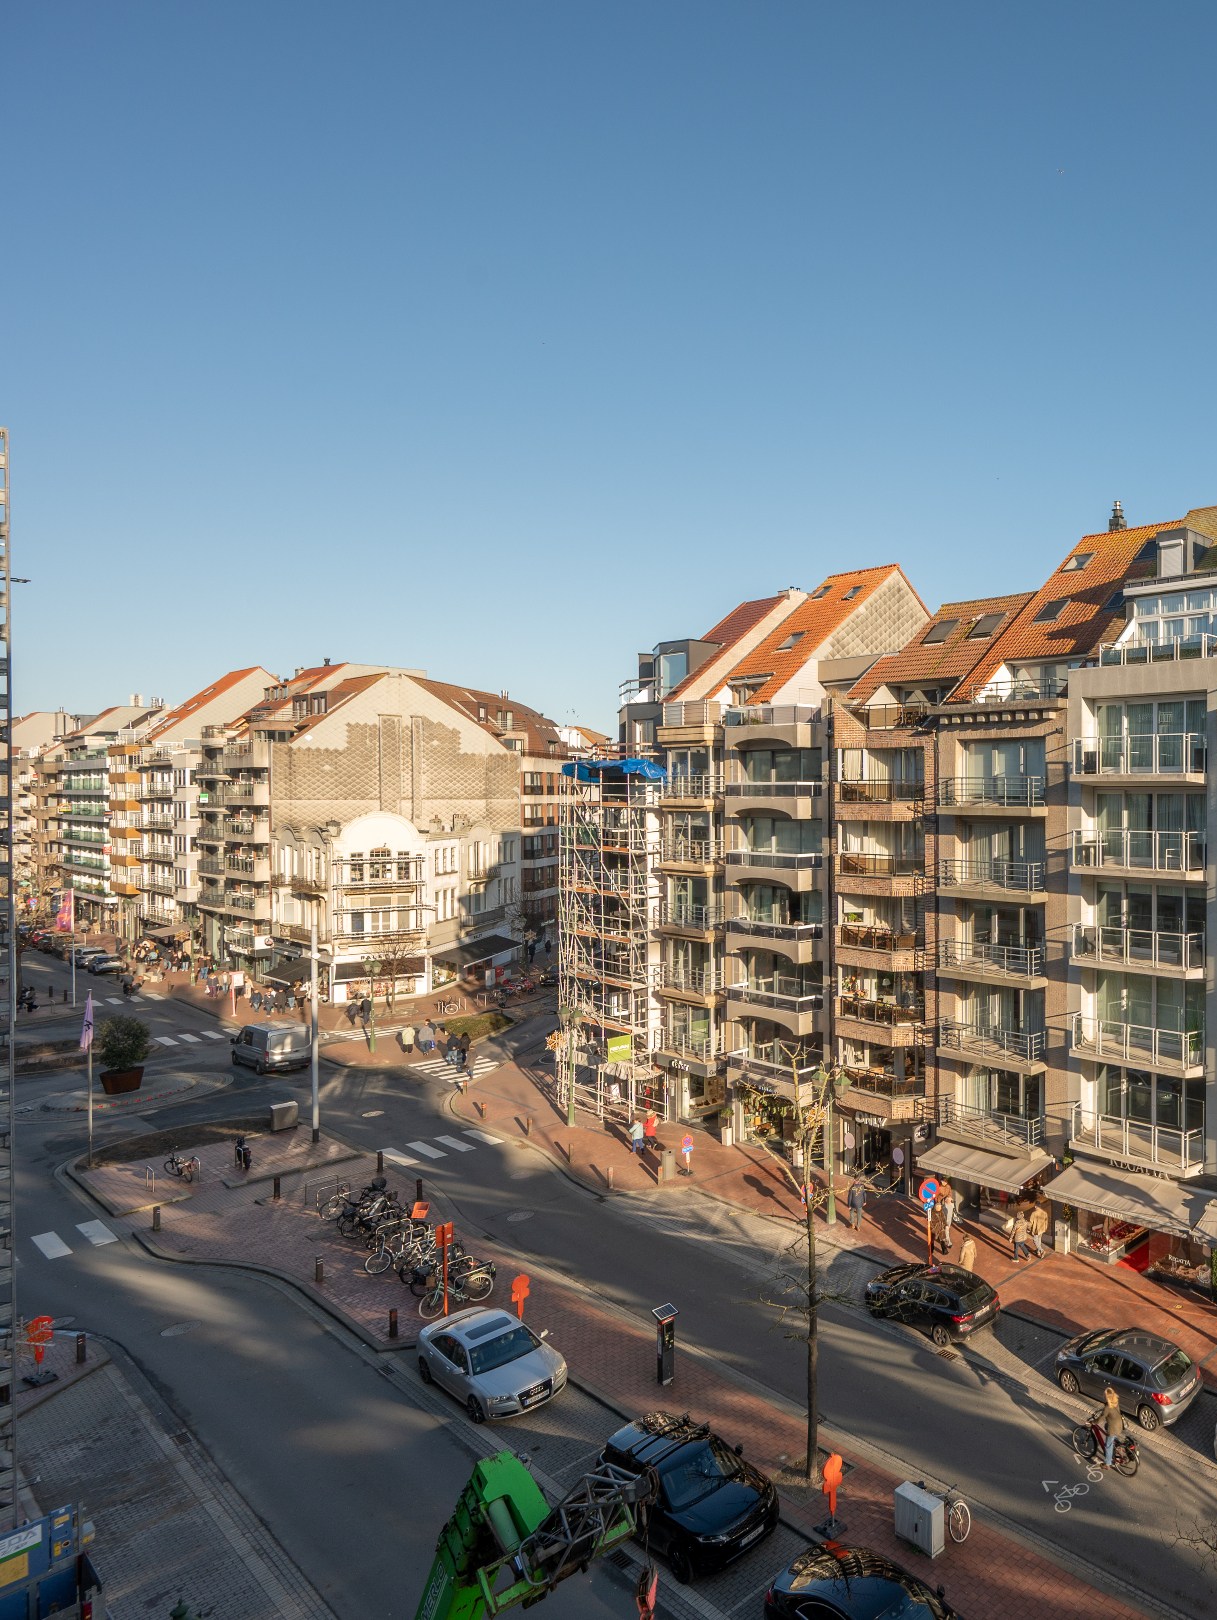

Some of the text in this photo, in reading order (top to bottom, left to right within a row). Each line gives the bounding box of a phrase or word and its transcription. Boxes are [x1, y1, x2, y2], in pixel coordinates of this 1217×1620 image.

[855, 1111, 887, 1128] ONLY
[1101, 1208, 1124, 1220] REGATTA
[1168, 1254, 1191, 1266] REGATTA
